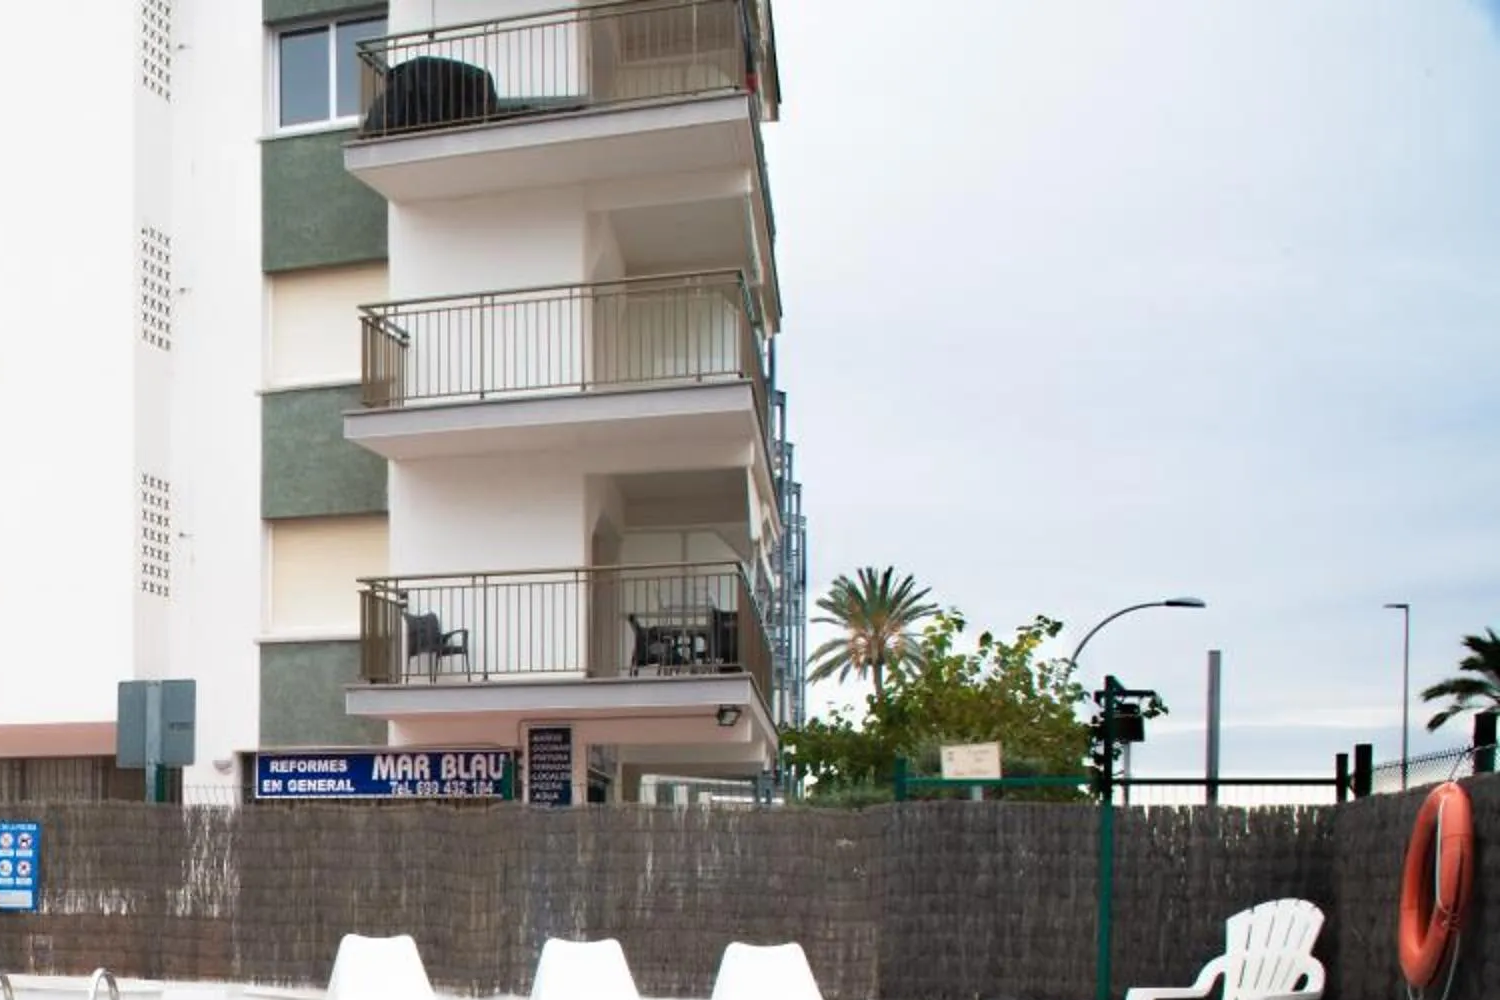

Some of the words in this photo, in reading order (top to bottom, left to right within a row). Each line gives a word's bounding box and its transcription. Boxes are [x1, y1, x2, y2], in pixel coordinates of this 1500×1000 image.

[269, 759, 348, 773] REFORMES
[372, 754, 431, 781] MAR
[441, 754, 505, 781] BLAU
[262, 779, 283, 793] EN
[287, 779, 356, 793] GENERAL
